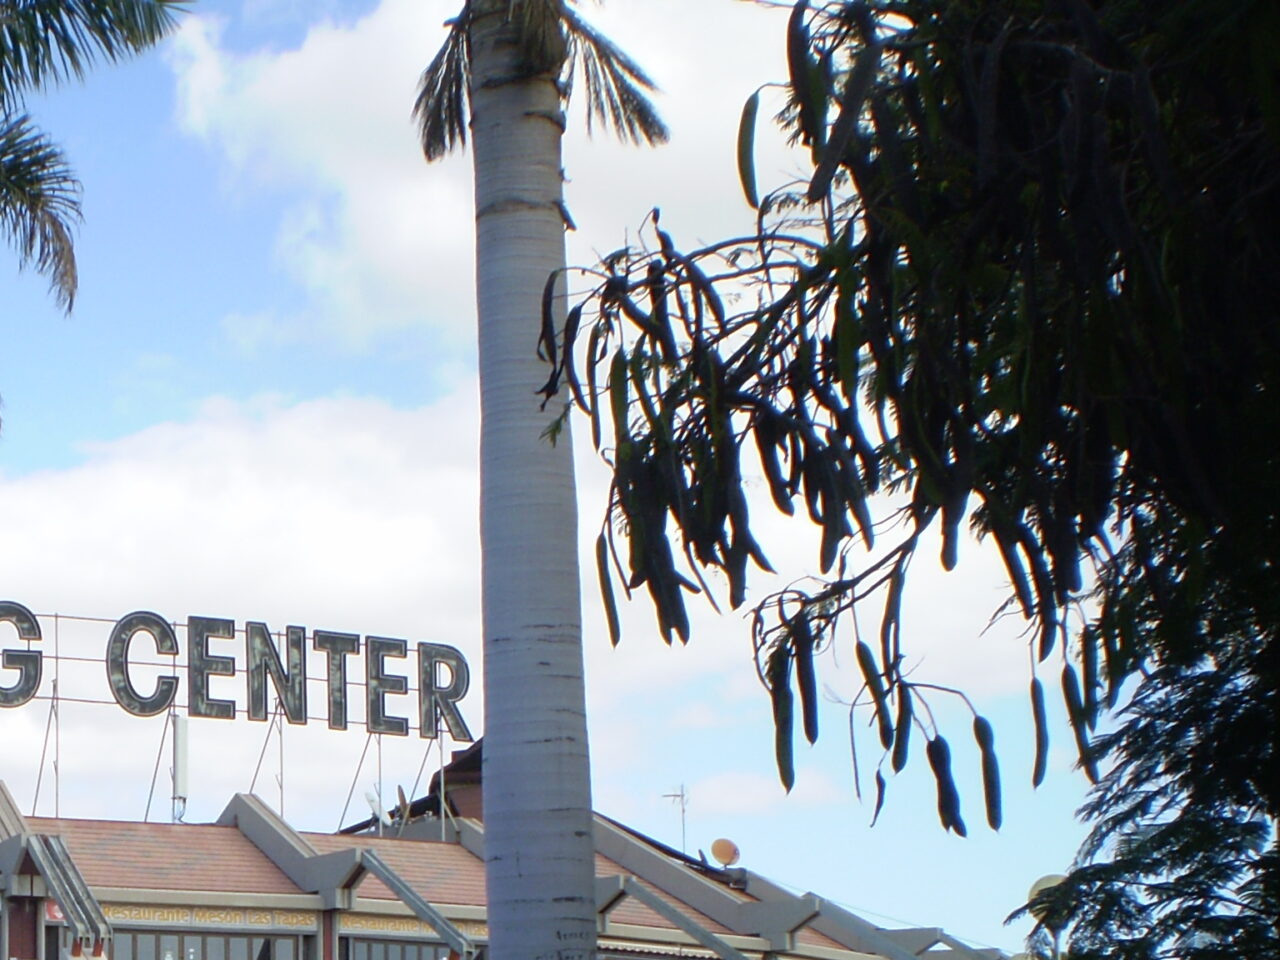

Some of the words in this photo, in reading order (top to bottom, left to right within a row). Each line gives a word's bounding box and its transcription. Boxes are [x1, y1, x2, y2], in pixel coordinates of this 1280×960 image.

[106, 610, 474, 743] CENTER
[102, 904, 190, 922] Restaurante
[246, 910, 272, 925] Las
[273, 910, 316, 929] Tapas
